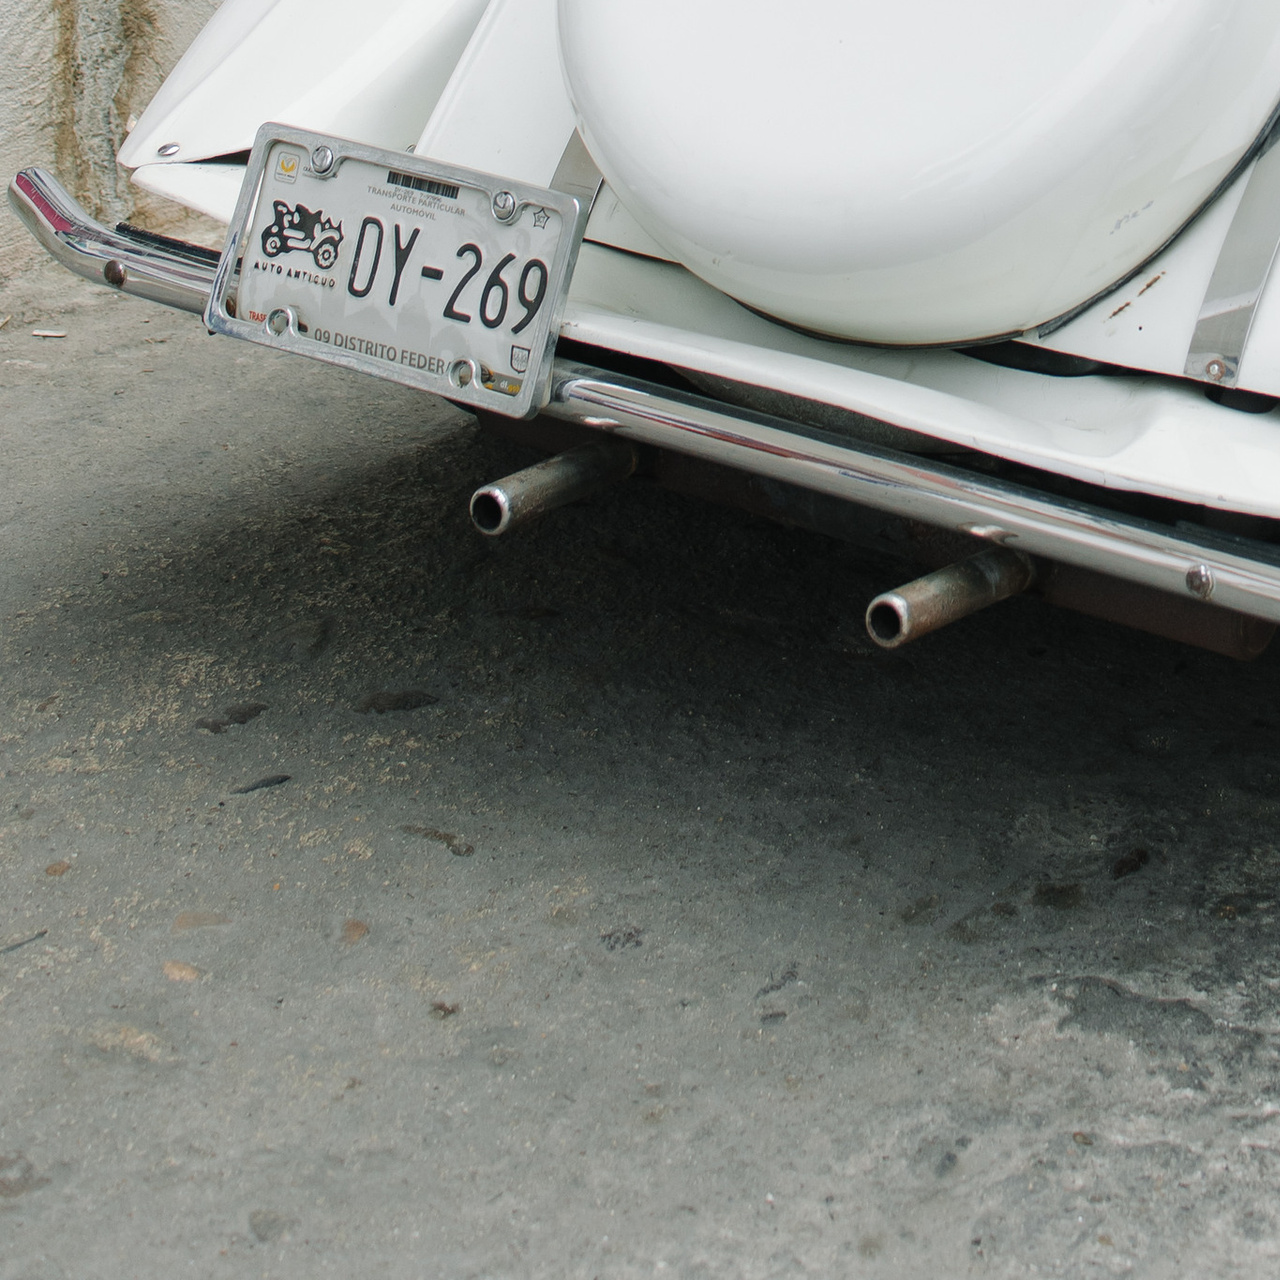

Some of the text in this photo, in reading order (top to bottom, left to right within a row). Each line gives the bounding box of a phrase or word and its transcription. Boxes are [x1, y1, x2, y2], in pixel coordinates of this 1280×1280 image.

[367, 185, 465, 217] TRANSPORTE PARTICULAR
[254, 261, 335, 288] AUTO ANTIGUO
[348, 216, 549, 335] DY-269
[314, 328, 451, 374] 09 DISTRITO FEDER
